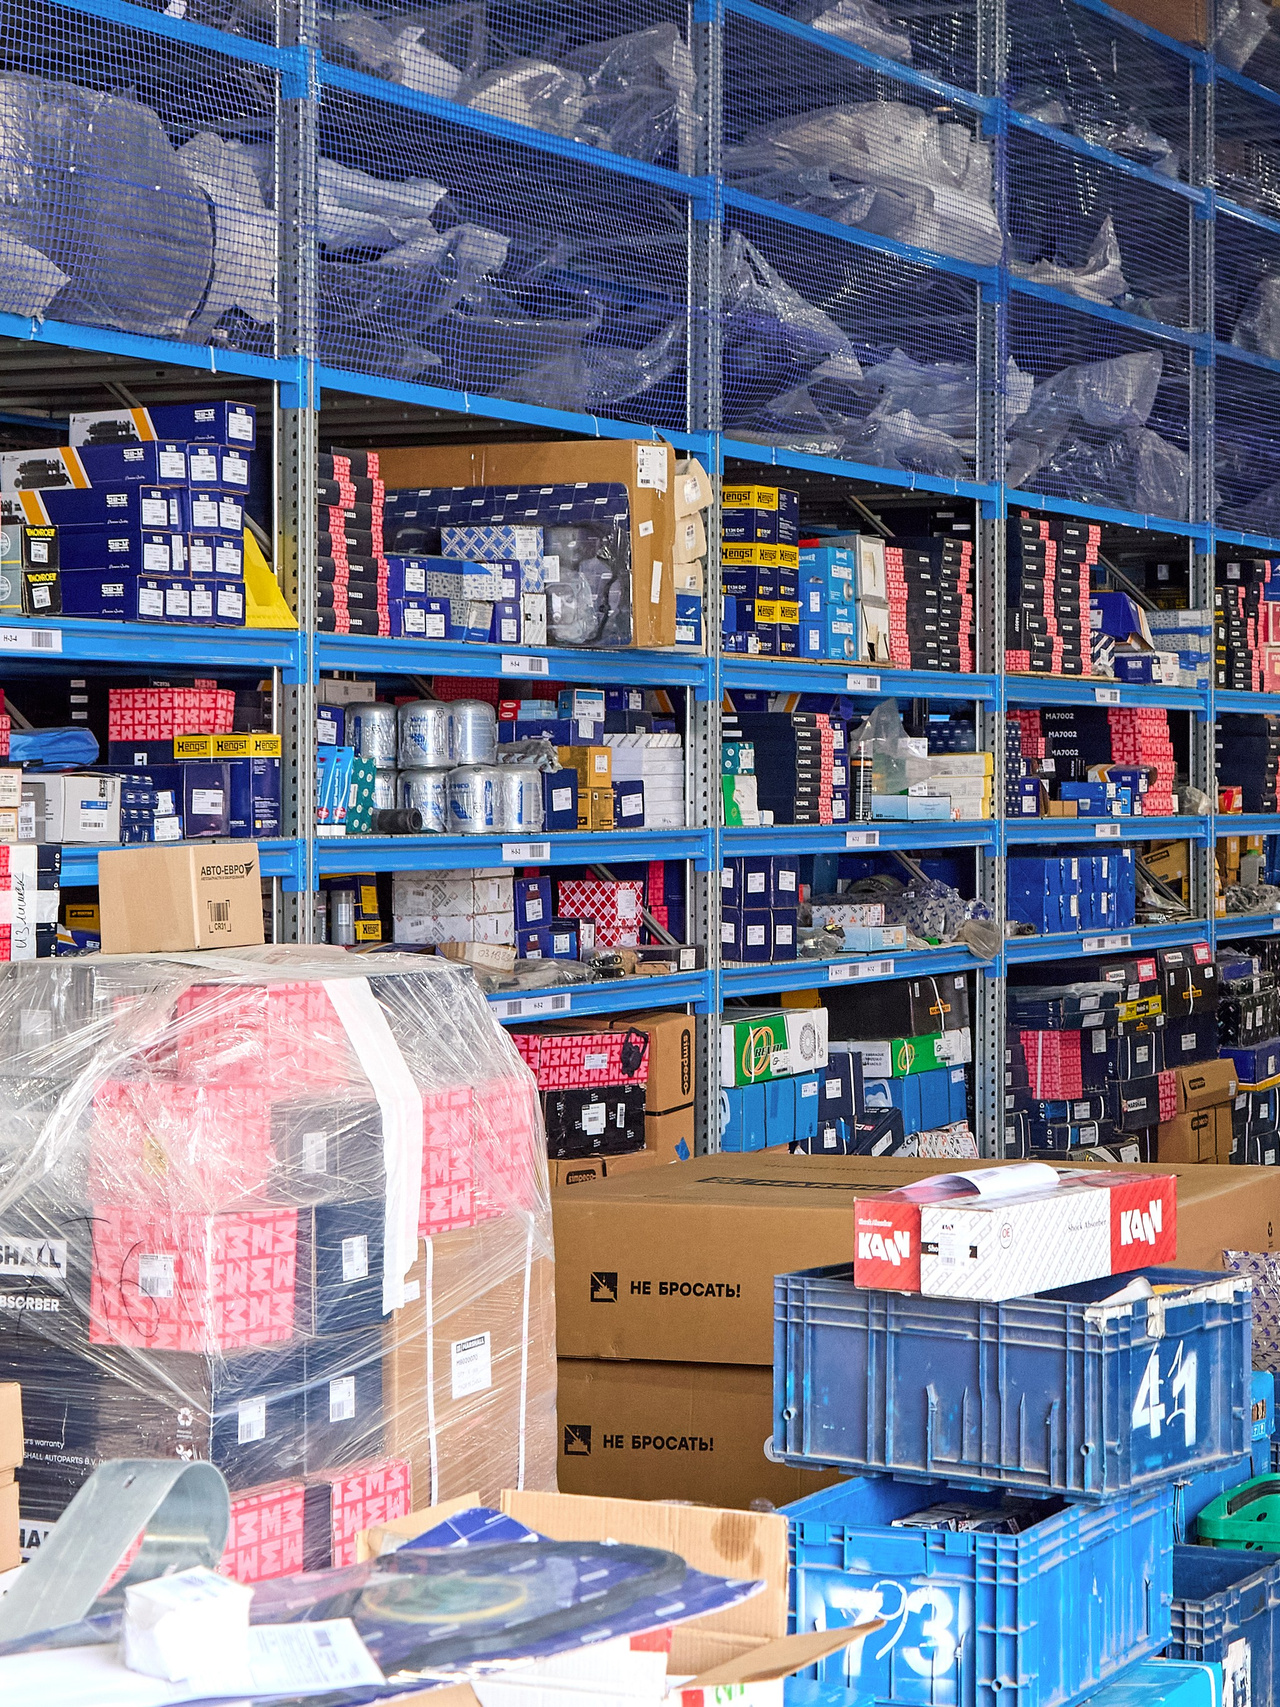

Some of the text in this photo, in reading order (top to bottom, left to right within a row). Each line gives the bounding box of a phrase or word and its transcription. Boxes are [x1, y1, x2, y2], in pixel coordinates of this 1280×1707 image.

[26, 528, 55, 537] MONROE
[27, 573, 57, 582] MONROE
[177, 741, 208, 753] Hengst
[217, 740, 247, 752] Hengst
[255, 740, 279, 751] Hengst
[201, 864, 245, 876] АВТО-ЕВРО
[214, 922, 227, 931] CR31
[681, 1034, 691, 1094] simpeco
[568, 1173, 596, 1184] simpeco
[630, 1281, 742, 1299] НЕ БРОСАТЬ!
[462, 1337, 485, 1350] MARSHALL
[1131, 1341, 1198, 1447] 41
[35, 1440, 65, 1450] warranty
[603, 1434, 714, 1452] НЕ БРОСАТЬ!
[45, 1454, 84, 1465] AUTOPARTS
